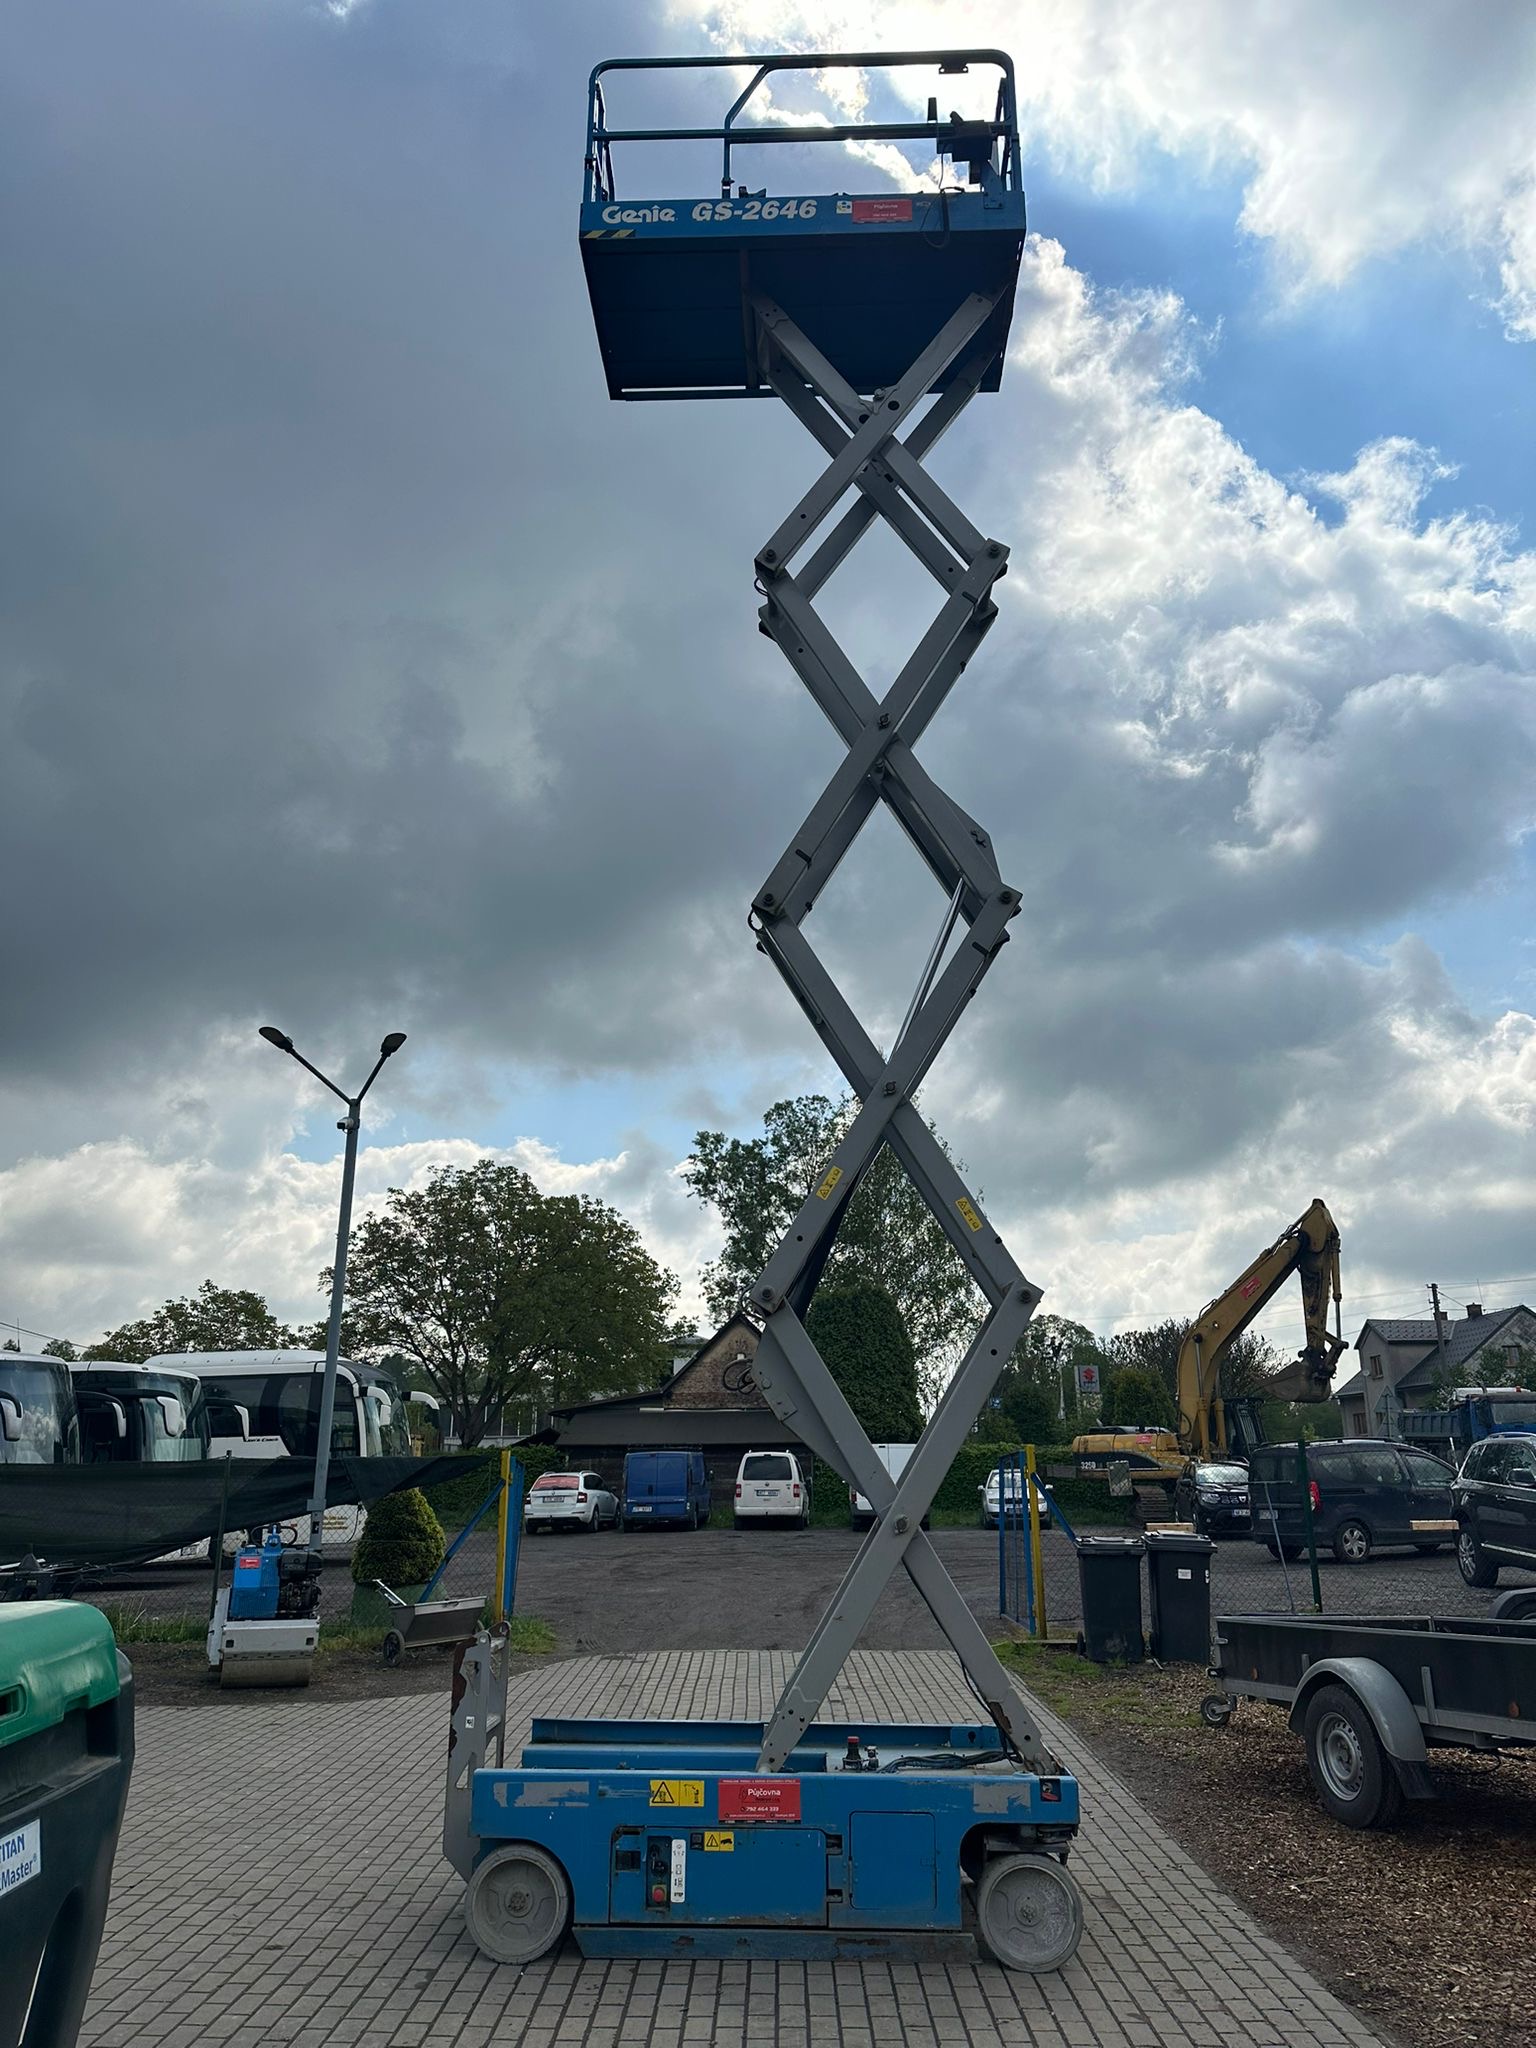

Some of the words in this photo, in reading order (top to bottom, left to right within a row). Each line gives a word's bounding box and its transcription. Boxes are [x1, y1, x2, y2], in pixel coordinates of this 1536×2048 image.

[602, 205, 676, 224] Genie
[691, 199, 818, 221] GS-2646
[747, 1788, 781, 1797] Půjčovna
